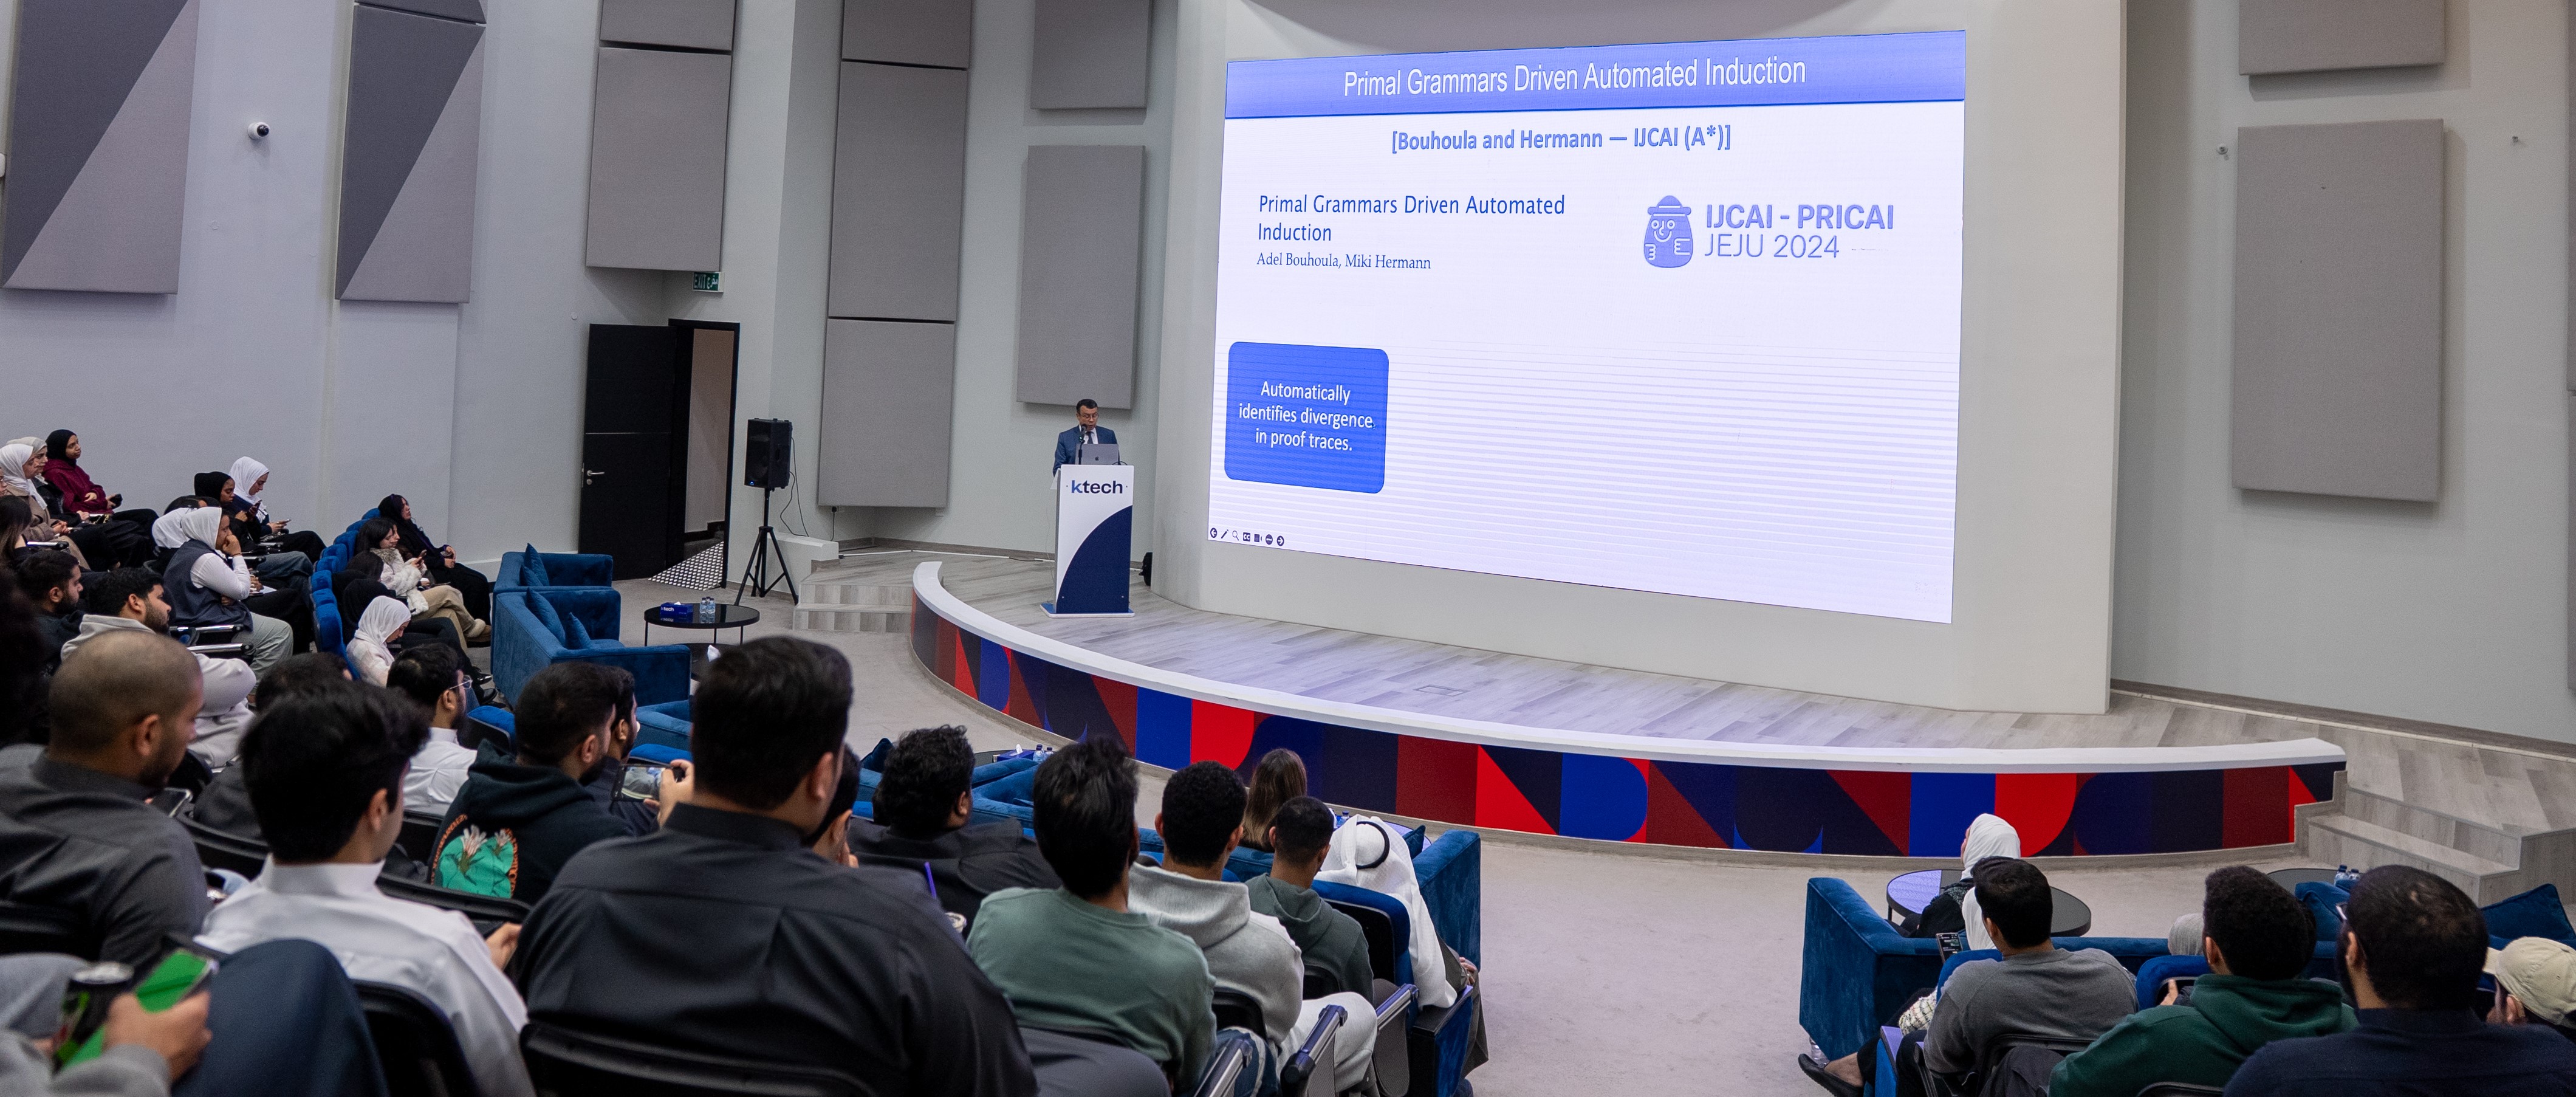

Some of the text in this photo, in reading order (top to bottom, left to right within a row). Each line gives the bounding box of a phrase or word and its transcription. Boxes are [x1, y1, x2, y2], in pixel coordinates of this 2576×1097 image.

[1345, 55, 1806, 97] Primal Grammars Driven Automated Induction
[1392, 129, 1477, 154] [Bouhoula
[1482, 129, 1515, 149] and
[1520, 129, 1603, 148] Hermann
[1634, 127, 1678, 147] IJCAI
[1259, 194, 1564, 215] Primal Grammars Driven Automated
[1707, 204, 1773, 229] IJCAI
[1798, 204, 1894, 230] PRICAI
[1258, 222, 1331, 241] Induction
[1704, 233, 1840, 258] JEJU 2024
[1256, 252, 1431, 269] Adel Bouhoula, Miki Hermann
[694, 274, 707, 289] EXIT
[1260, 380, 1351, 405] Automatically
[1239, 404, 1373, 430] identifies divergence
[1256, 427, 1352, 452] in proof traces.
[1071, 480, 1123, 494] ktech
